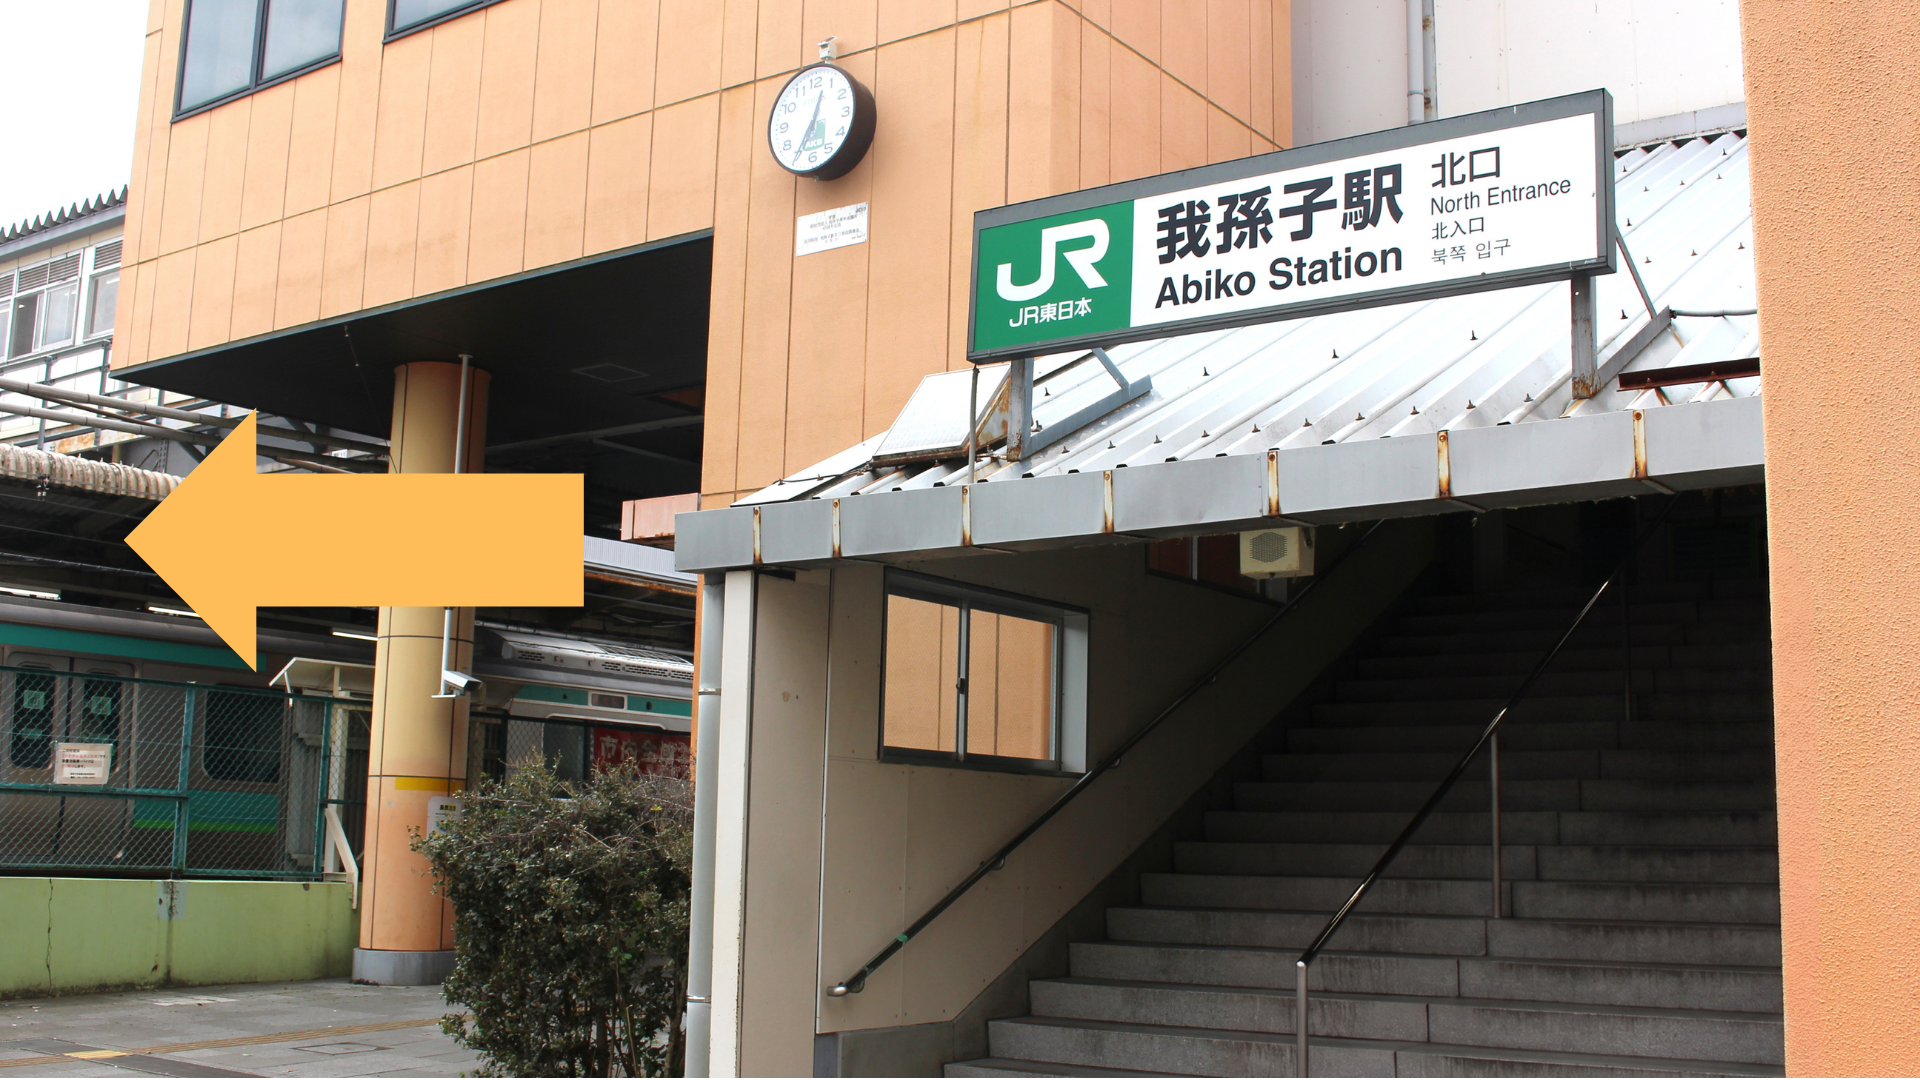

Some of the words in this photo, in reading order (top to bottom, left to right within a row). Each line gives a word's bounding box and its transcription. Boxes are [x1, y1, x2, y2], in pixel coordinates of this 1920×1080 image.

[810, 76, 823, 90] 12
[829, 78, 834, 89] 1
[795, 85, 806, 98] 11
[837, 88, 847, 100] 2
[783, 102, 797, 115] 10
[841, 106, 850, 117] 3
[779, 122, 789, 133] 9
[835, 125, 846, 137] 4
[782, 139, 792, 151] 8
[824, 142, 833, 154] 5
[808, 151, 818, 163] 6
[1431, 146, 1501, 188] 北口
[1431, 191, 1480, 216] North
[1488, 179, 1571, 206] Entrance
[1156, 163, 1404, 265] 我孫子駅
[1431, 216, 1485, 240] 北入口
[1431, 245, 1467, 265] 북쪽
[1475, 238, 1511, 260] 입구
[996, 218, 1110, 302] JR
[1154, 268, 1256, 309] Abiko
[1268, 246, 1402, 290] Station
[1009, 297, 1092, 328] JR東日本
